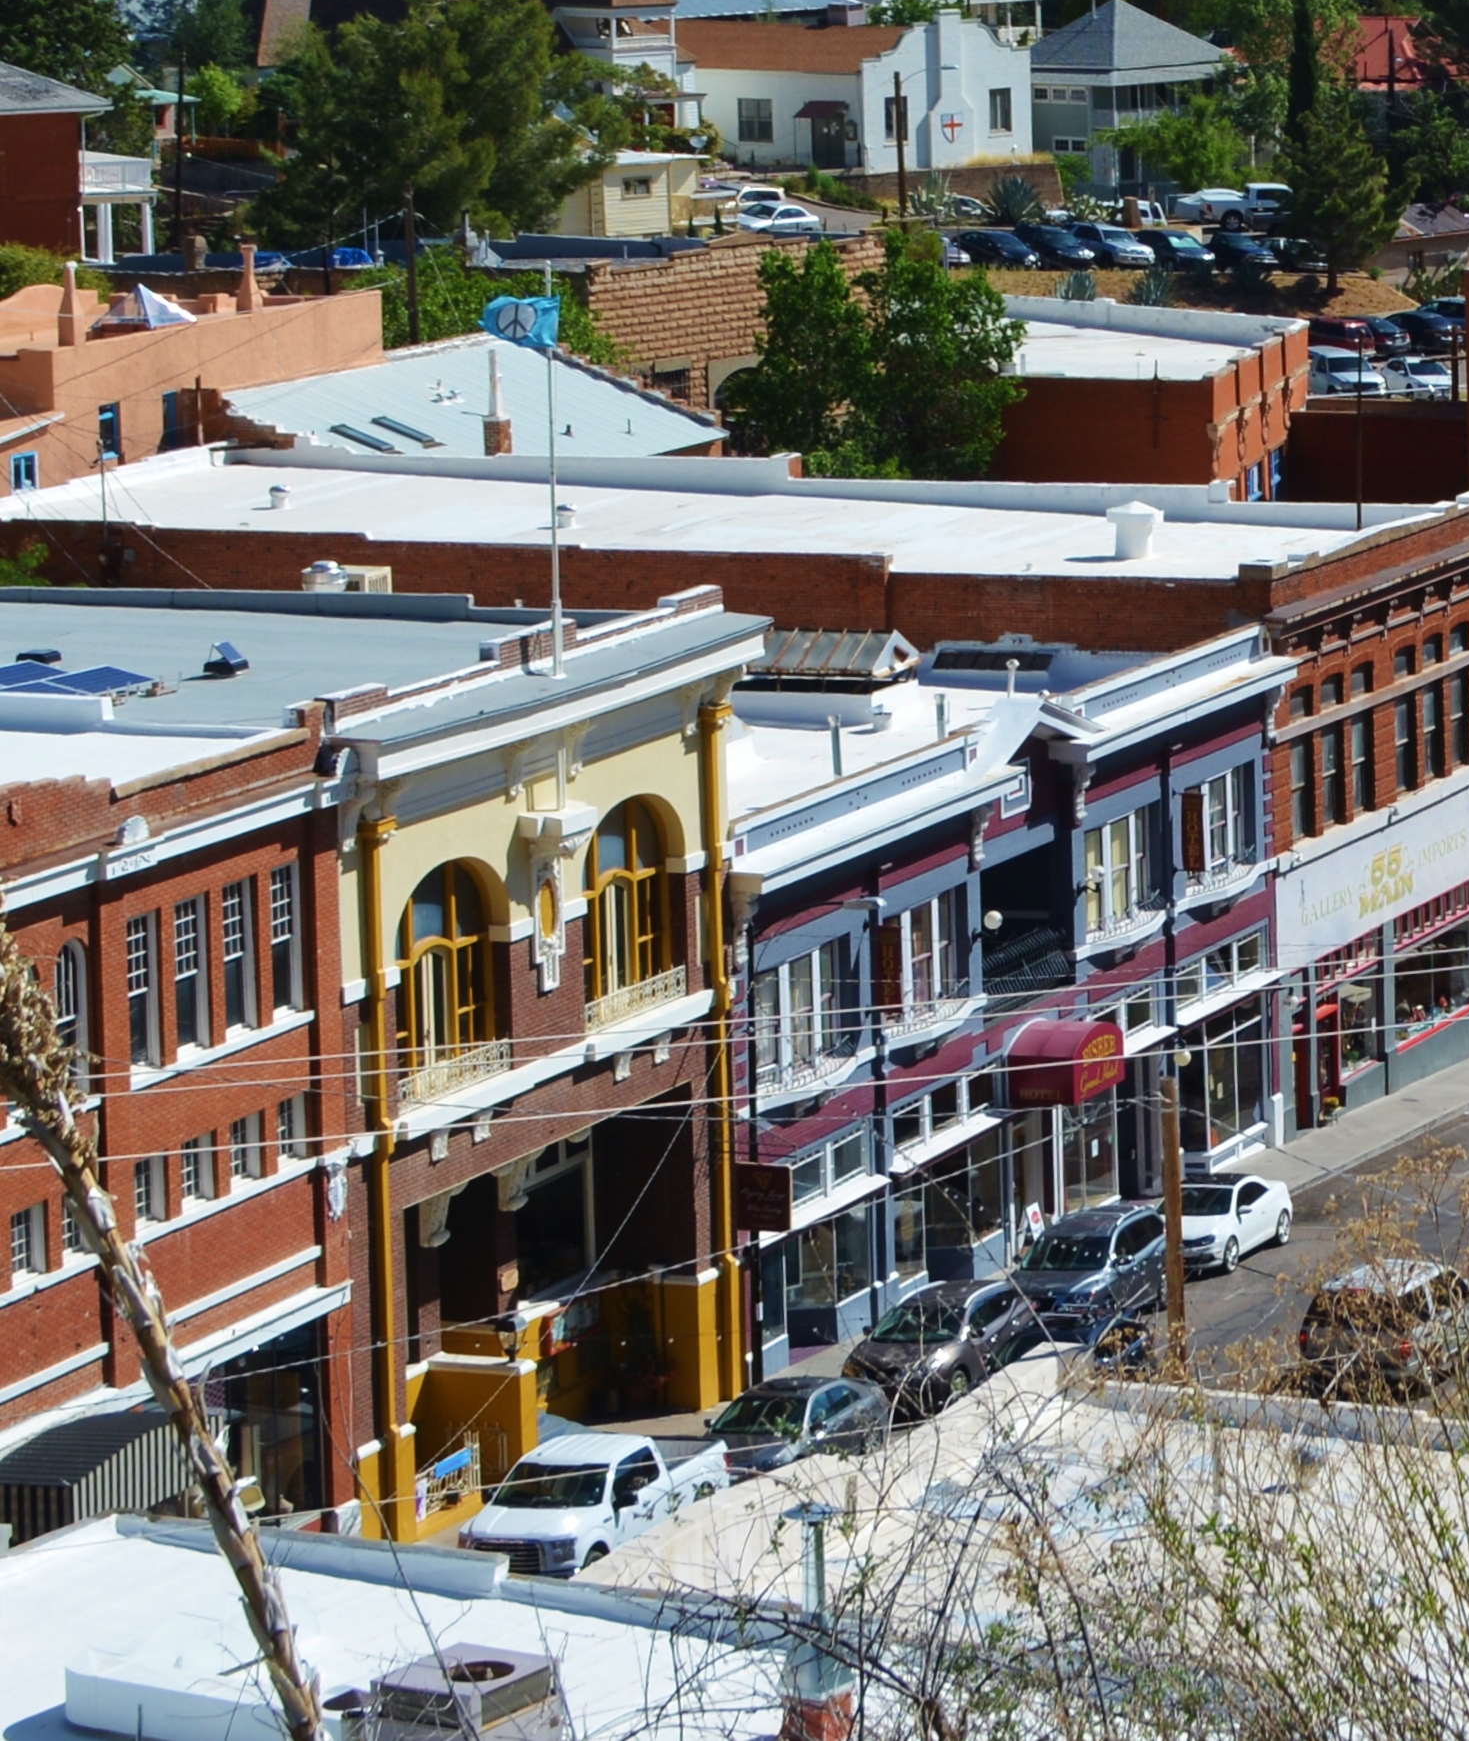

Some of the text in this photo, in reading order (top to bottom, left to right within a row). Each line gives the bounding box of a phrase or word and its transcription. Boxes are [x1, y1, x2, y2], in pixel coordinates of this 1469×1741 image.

[1186, 810, 1200, 868] HOTEL
[1301, 886, 1353, 927] GALLERY
[1371, 842, 1403, 886] 55
[1418, 828, 1468, 869] IMPORTS
[1358, 869, 1416, 920] MAIN
[1082, 1034, 1117, 1068] BISBEE
[1020, 1088, 1063, 1101] HOTEL
[1080, 1066, 1101, 1098] Grand
